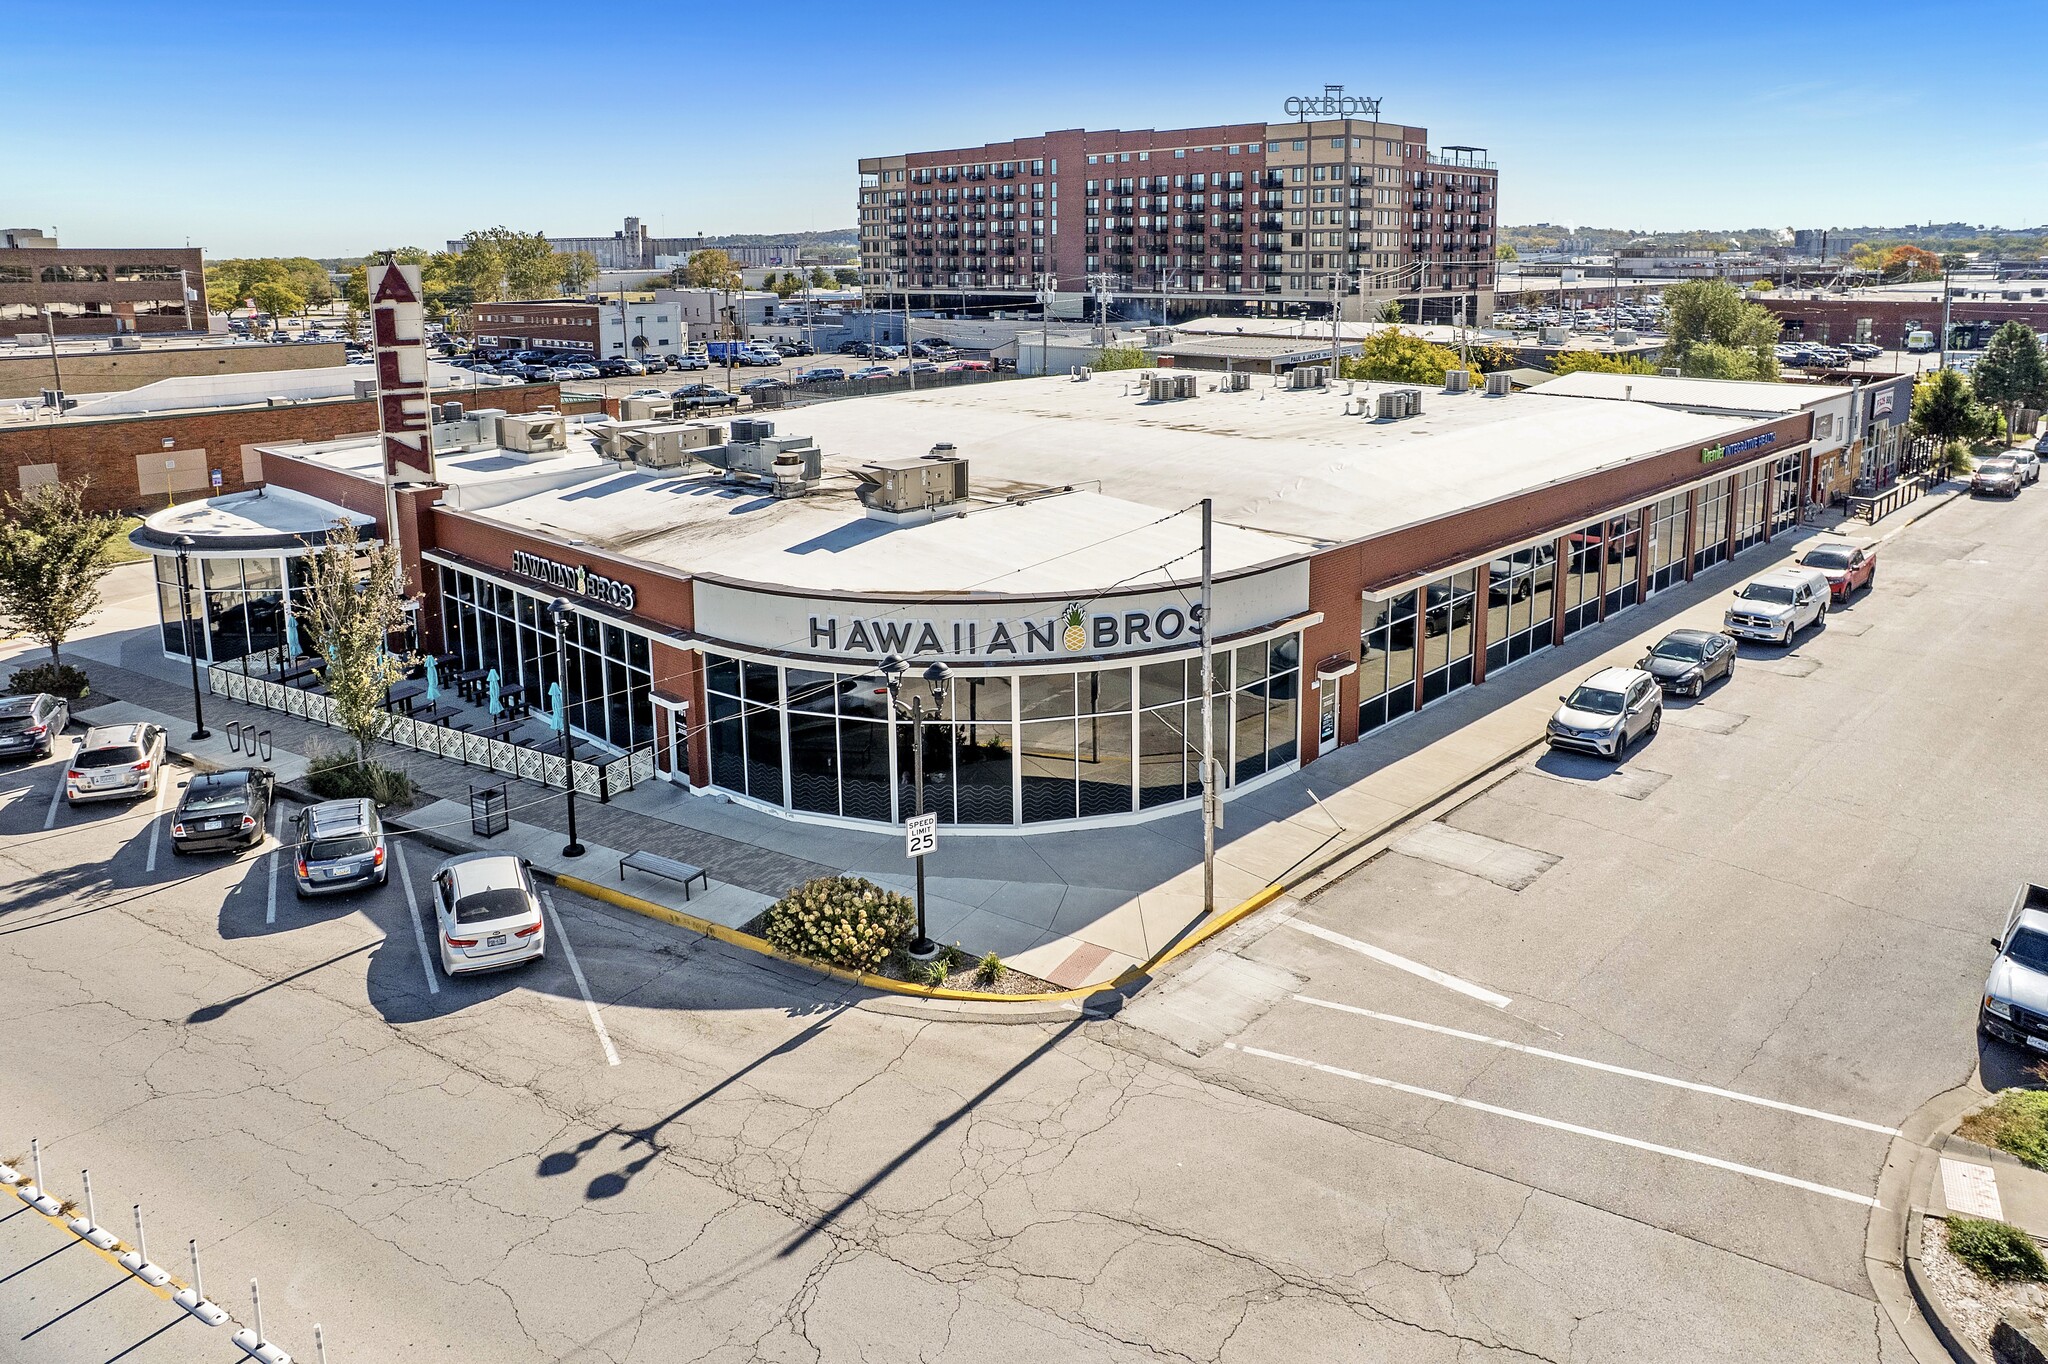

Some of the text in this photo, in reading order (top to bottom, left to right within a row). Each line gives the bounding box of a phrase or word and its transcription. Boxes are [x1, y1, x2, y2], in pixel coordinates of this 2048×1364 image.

[1284, 96, 1383, 116] OXBOW
[373, 257, 430, 477] ALLEN
[1703, 432, 1776, 464] Premier INTEGRATIVE HEALTH
[511, 550, 634, 610] HAWAIIAN BROS
[808, 602, 1203, 656] HAWAIIAN BROS
[909, 818, 934, 829] SPEED
[912, 827, 931, 836] LIMIT
[910, 834, 934, 852] 25
